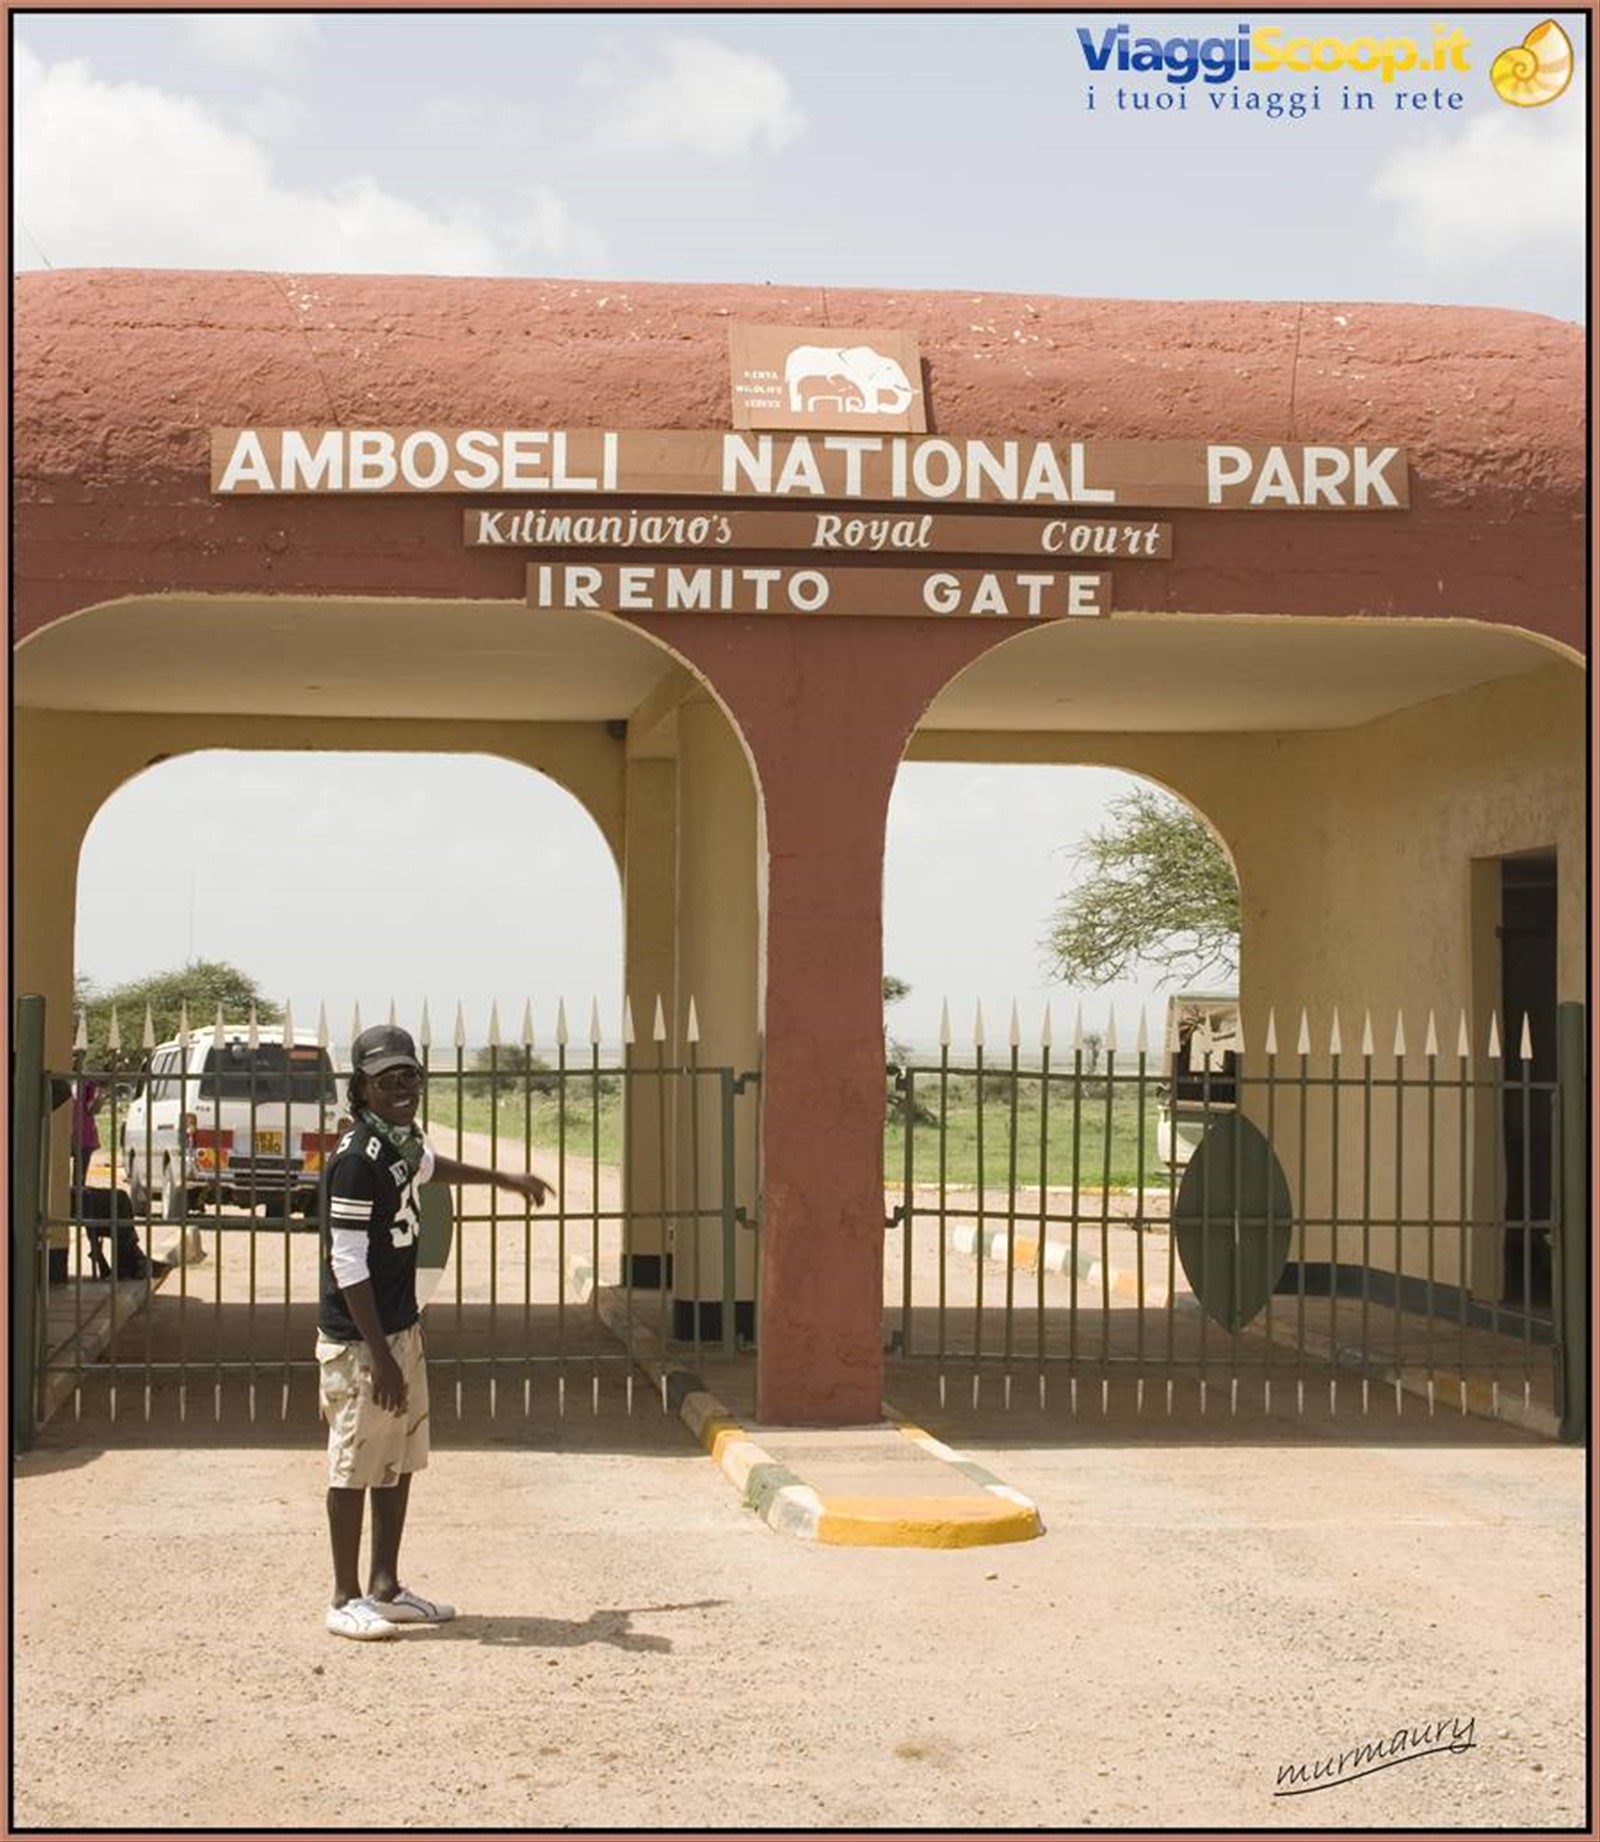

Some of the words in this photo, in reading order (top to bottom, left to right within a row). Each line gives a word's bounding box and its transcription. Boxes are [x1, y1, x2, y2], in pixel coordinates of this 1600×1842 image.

[218, 430, 618, 492] AMBOSELI
[721, 433, 1116, 502] NATIONAL
[1206, 444, 1401, 506] PARK
[476, 509, 733, 547] Kilimanjaro's
[811, 514, 933, 551] Royal
[1040, 520, 1161, 556] Court
[537, 565, 831, 613] IREMITO
[922, 572, 1101, 616] GATE
